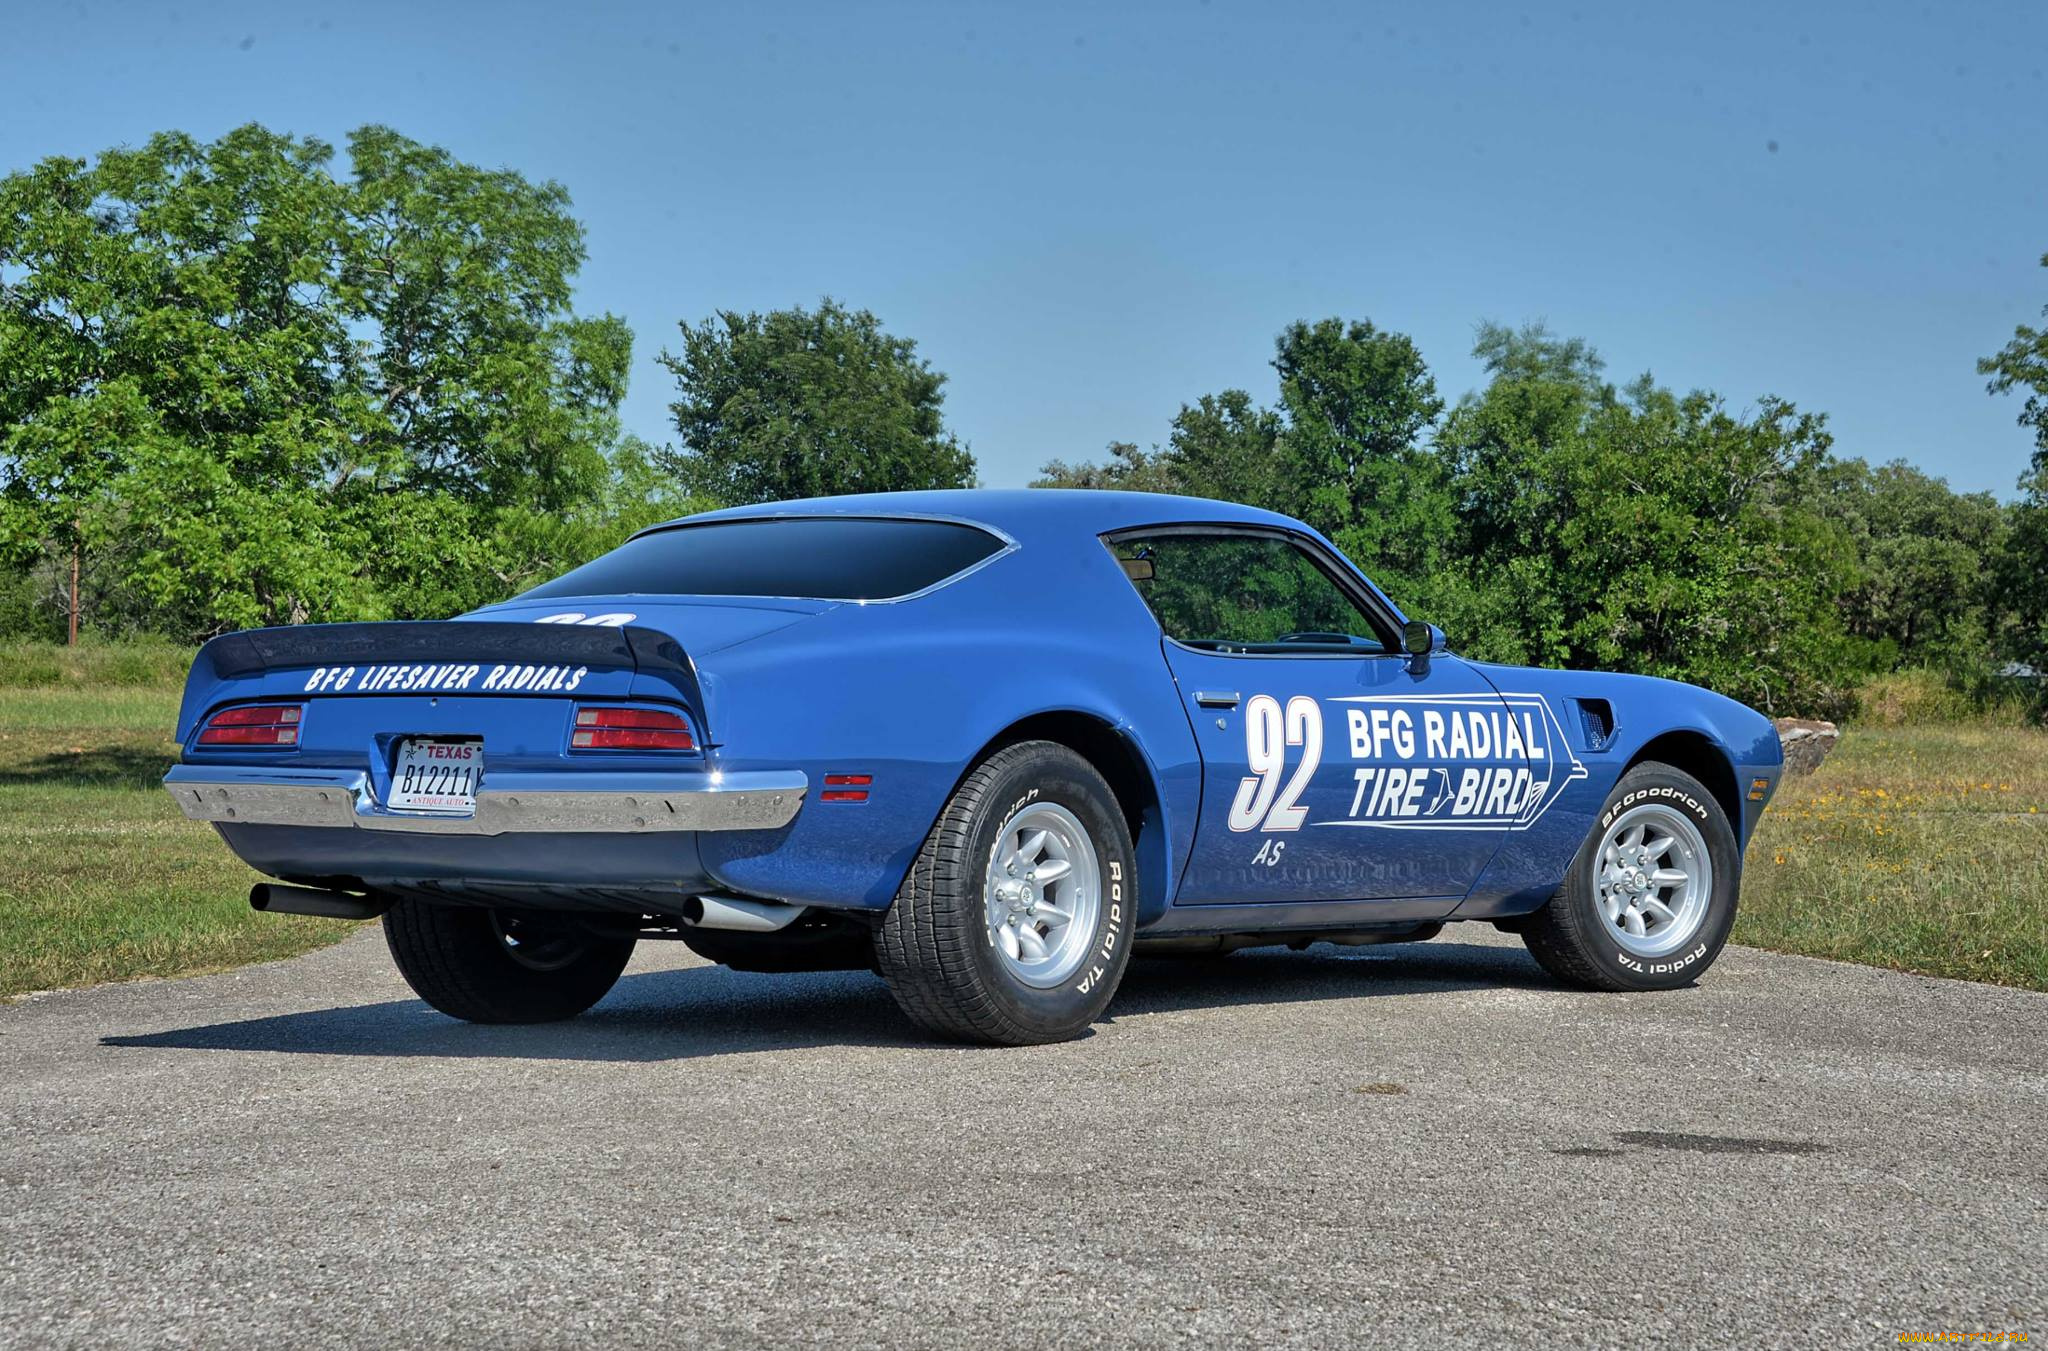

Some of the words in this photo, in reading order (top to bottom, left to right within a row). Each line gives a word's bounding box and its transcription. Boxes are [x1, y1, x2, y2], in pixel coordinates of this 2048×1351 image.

[304, 667, 355, 691] BFG
[357, 664, 479, 690] LIFESAVER
[481, 665, 587, 691] RADIALS
[427, 745, 473, 760] TEXAS
[1347, 709, 1414, 759] BFG
[1424, 710, 1545, 759] RADIAL
[1228, 694, 1323, 833] 92
[1349, 768, 1429, 817] TIRE
[1451, 768, 1533, 816] BIRD
[1601, 787, 1708, 829] BFGoodrich
[1251, 839, 1286, 867] AS
